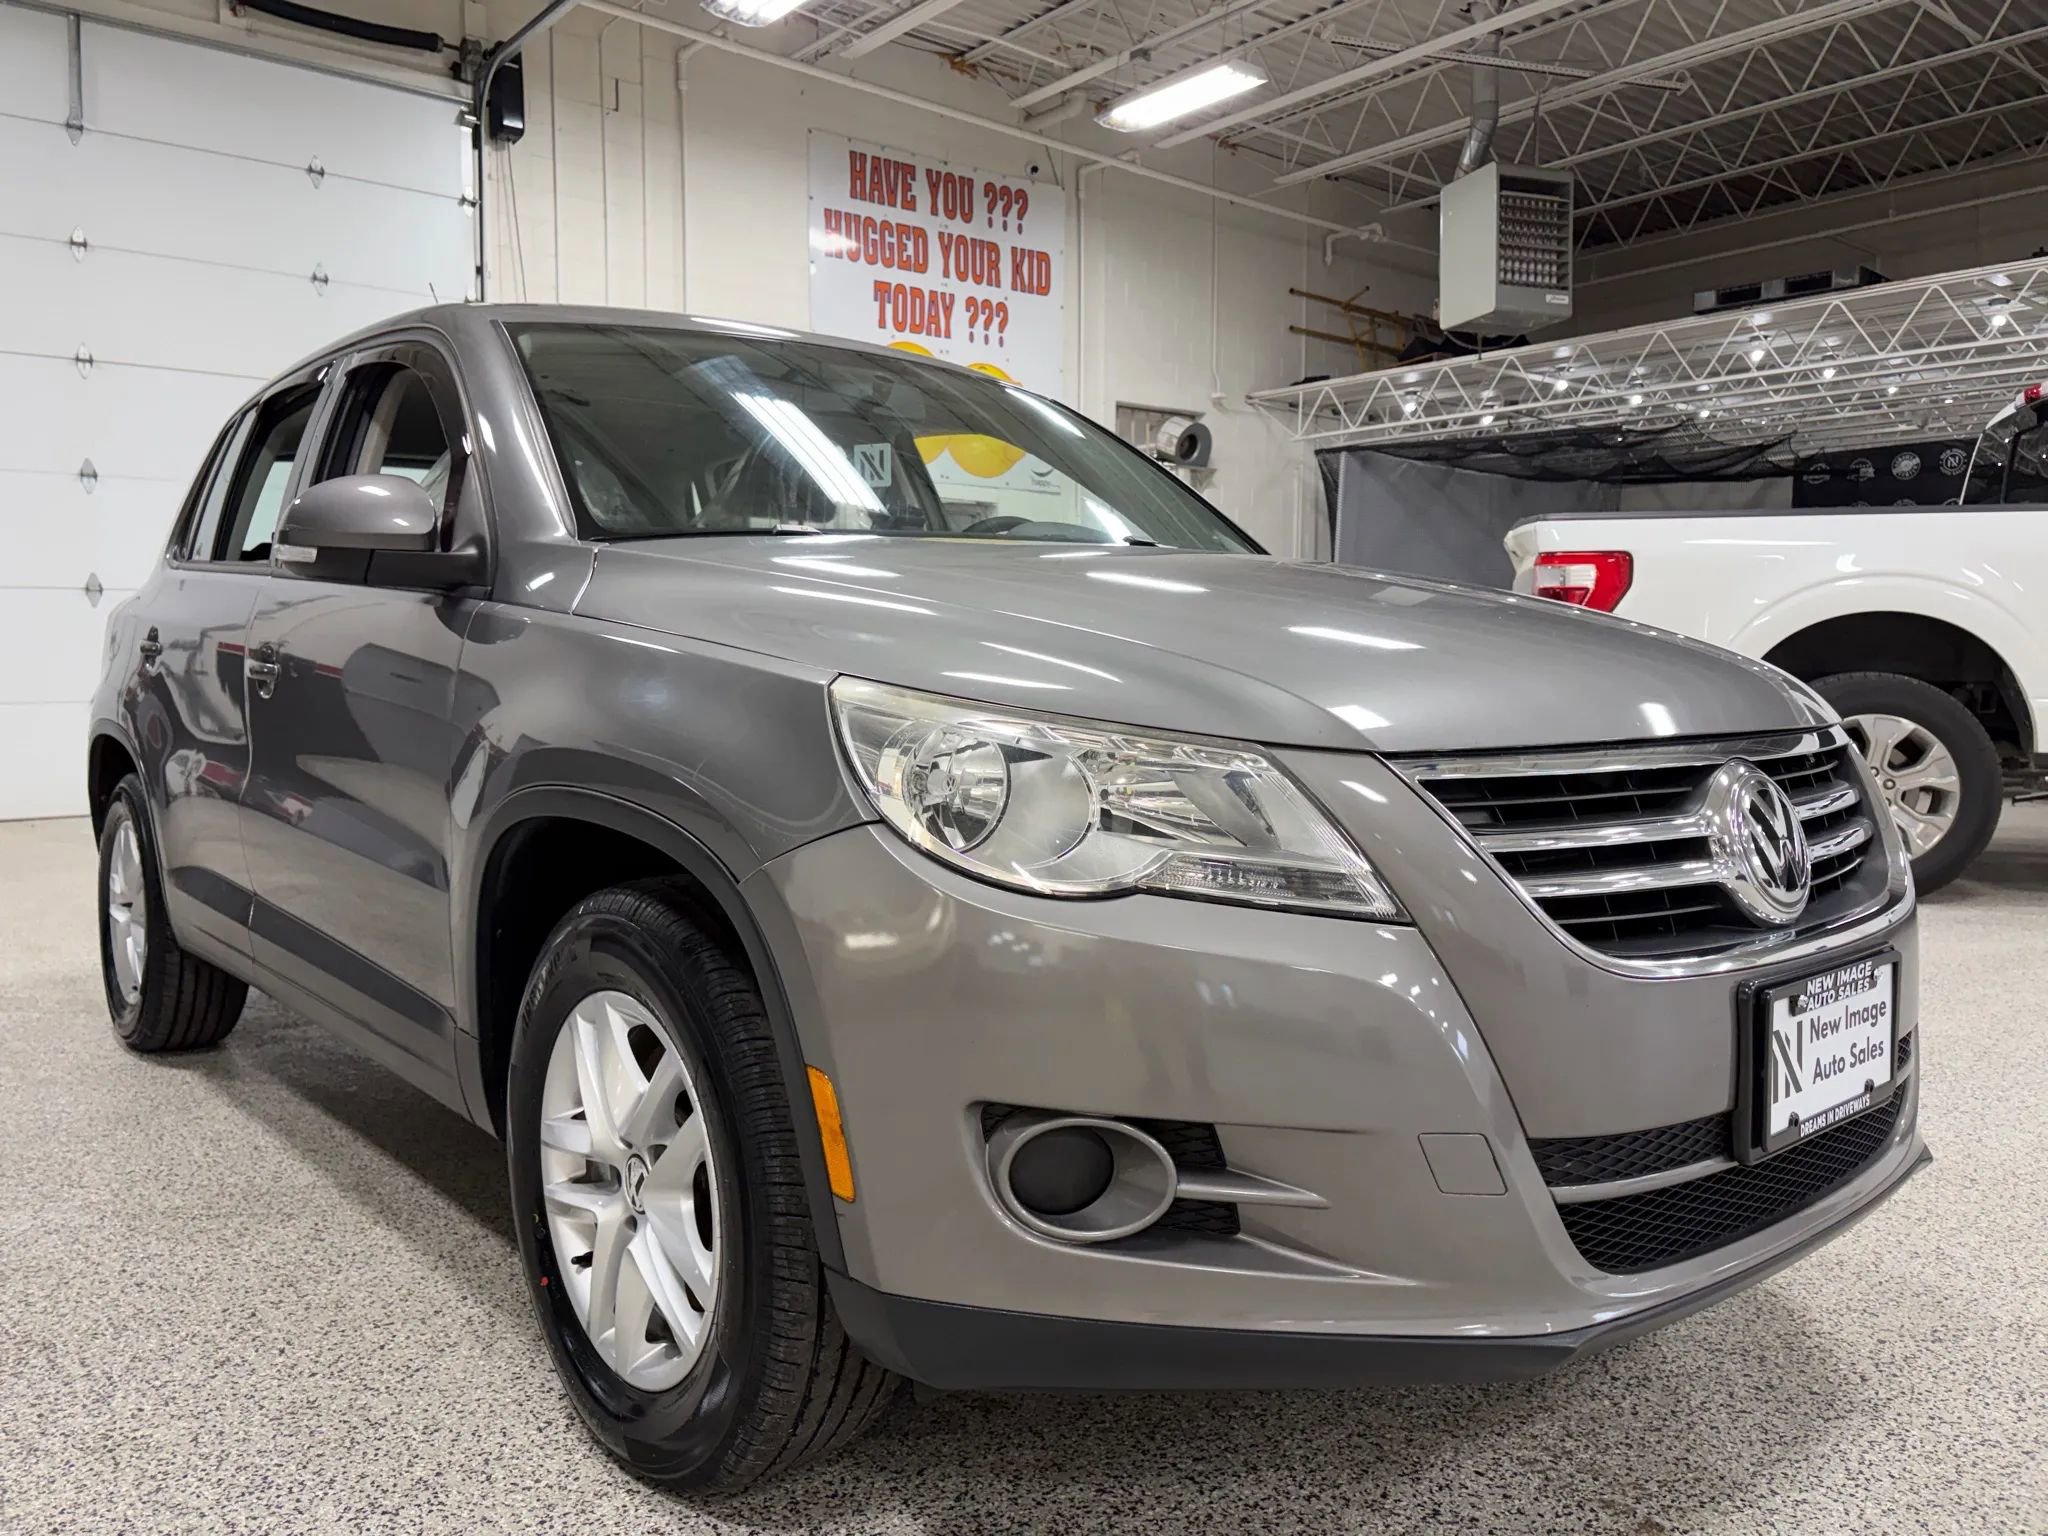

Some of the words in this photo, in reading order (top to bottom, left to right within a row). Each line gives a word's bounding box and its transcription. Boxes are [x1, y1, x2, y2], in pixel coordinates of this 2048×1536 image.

[849, 150, 917, 212] HAVE
[926, 168, 975, 224] YOU
[983, 182, 1029, 235] ???
[824, 208, 929, 274] HUGGED
[938, 231, 1001, 288] YOUR
[1010, 246, 1051, 296] KID
[873, 280, 955, 338] TODAY
[965, 295, 1009, 347] ???
[1806, 973, 1835, 996] NEW
[1837, 961, 1873, 984] IMAGE
[1806, 992, 1836, 1012] AUTO
[1838, 978, 1870, 1000] SALES
[1810, 1015, 1842, 1044] New
[1845, 1000, 1887, 1030] Image
[1813, 1057, 1845, 1085] Auto
[1849, 1036, 1884, 1069] Sales
[1800, 1115, 1827, 1138] DREAMS
[1827, 1111, 1835, 1123] IN
[1835, 1093, 1871, 1120] DRIVEWAYS
